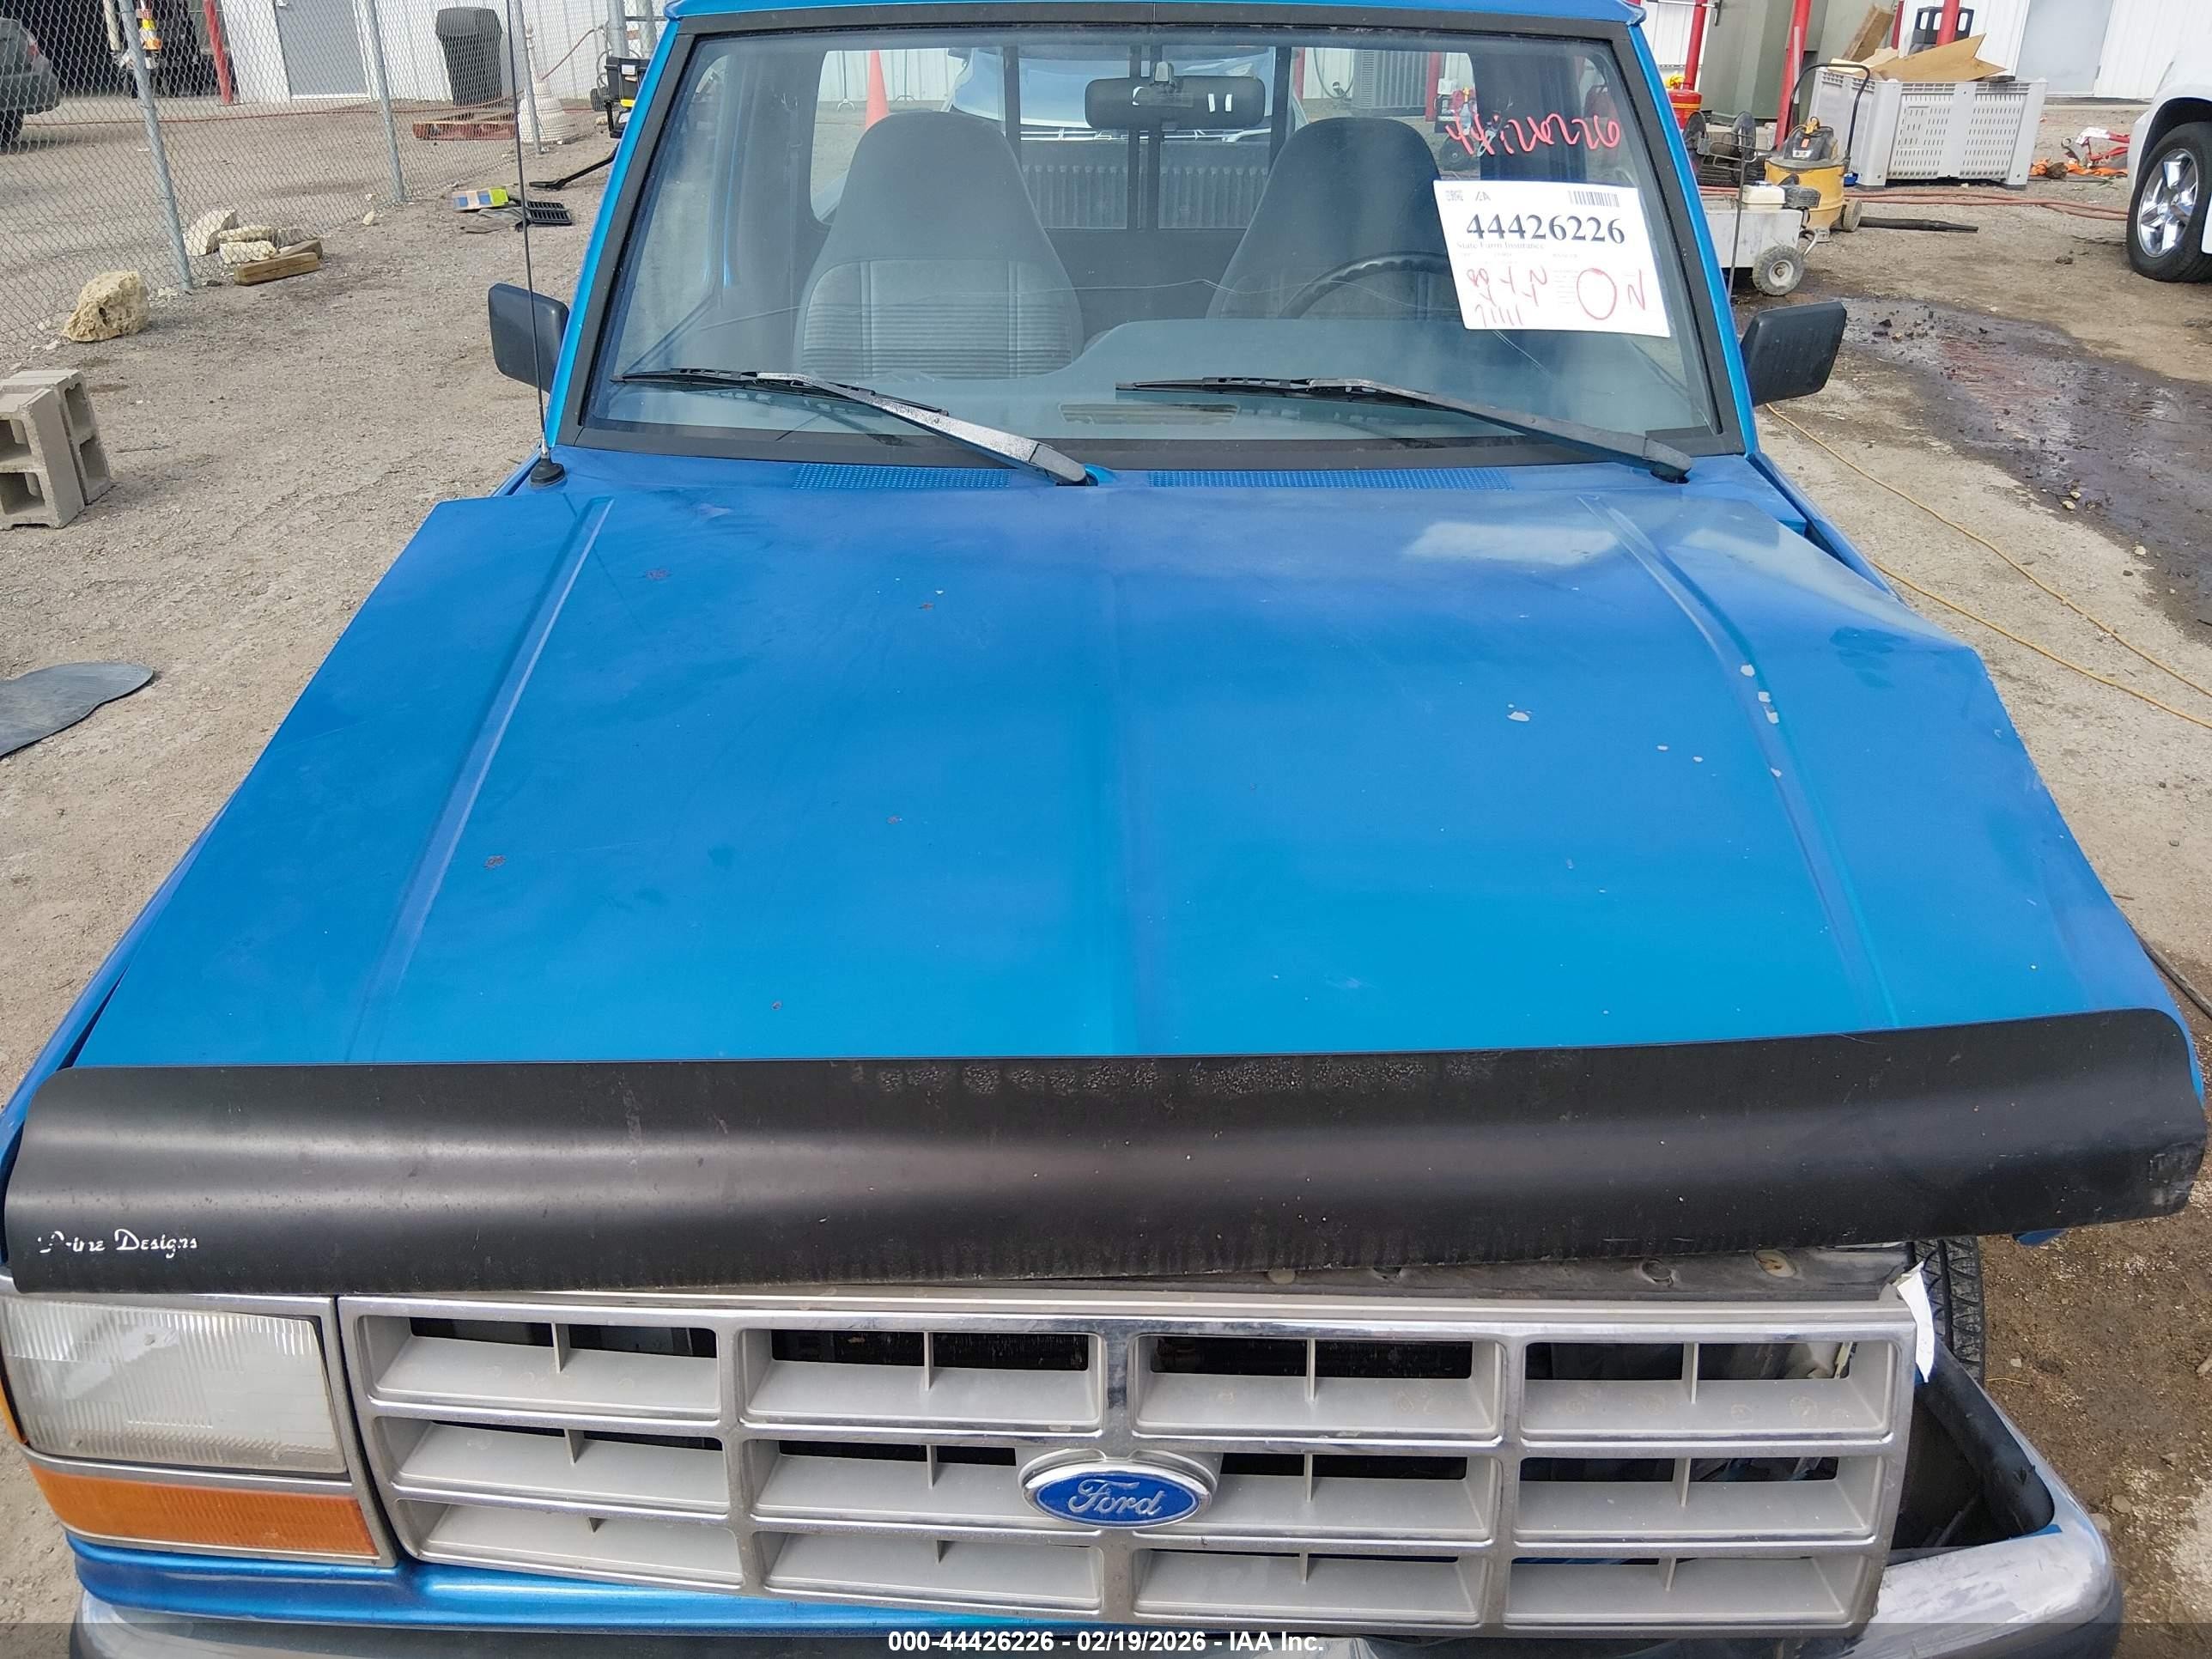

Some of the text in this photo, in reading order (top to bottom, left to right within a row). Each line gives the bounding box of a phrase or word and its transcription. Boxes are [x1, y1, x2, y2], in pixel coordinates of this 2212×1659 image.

[1466, 213, 1626, 245] 44426226
[114, 1228, 198, 1259] Designs
[1069, 1479, 1166, 1516] Ford
